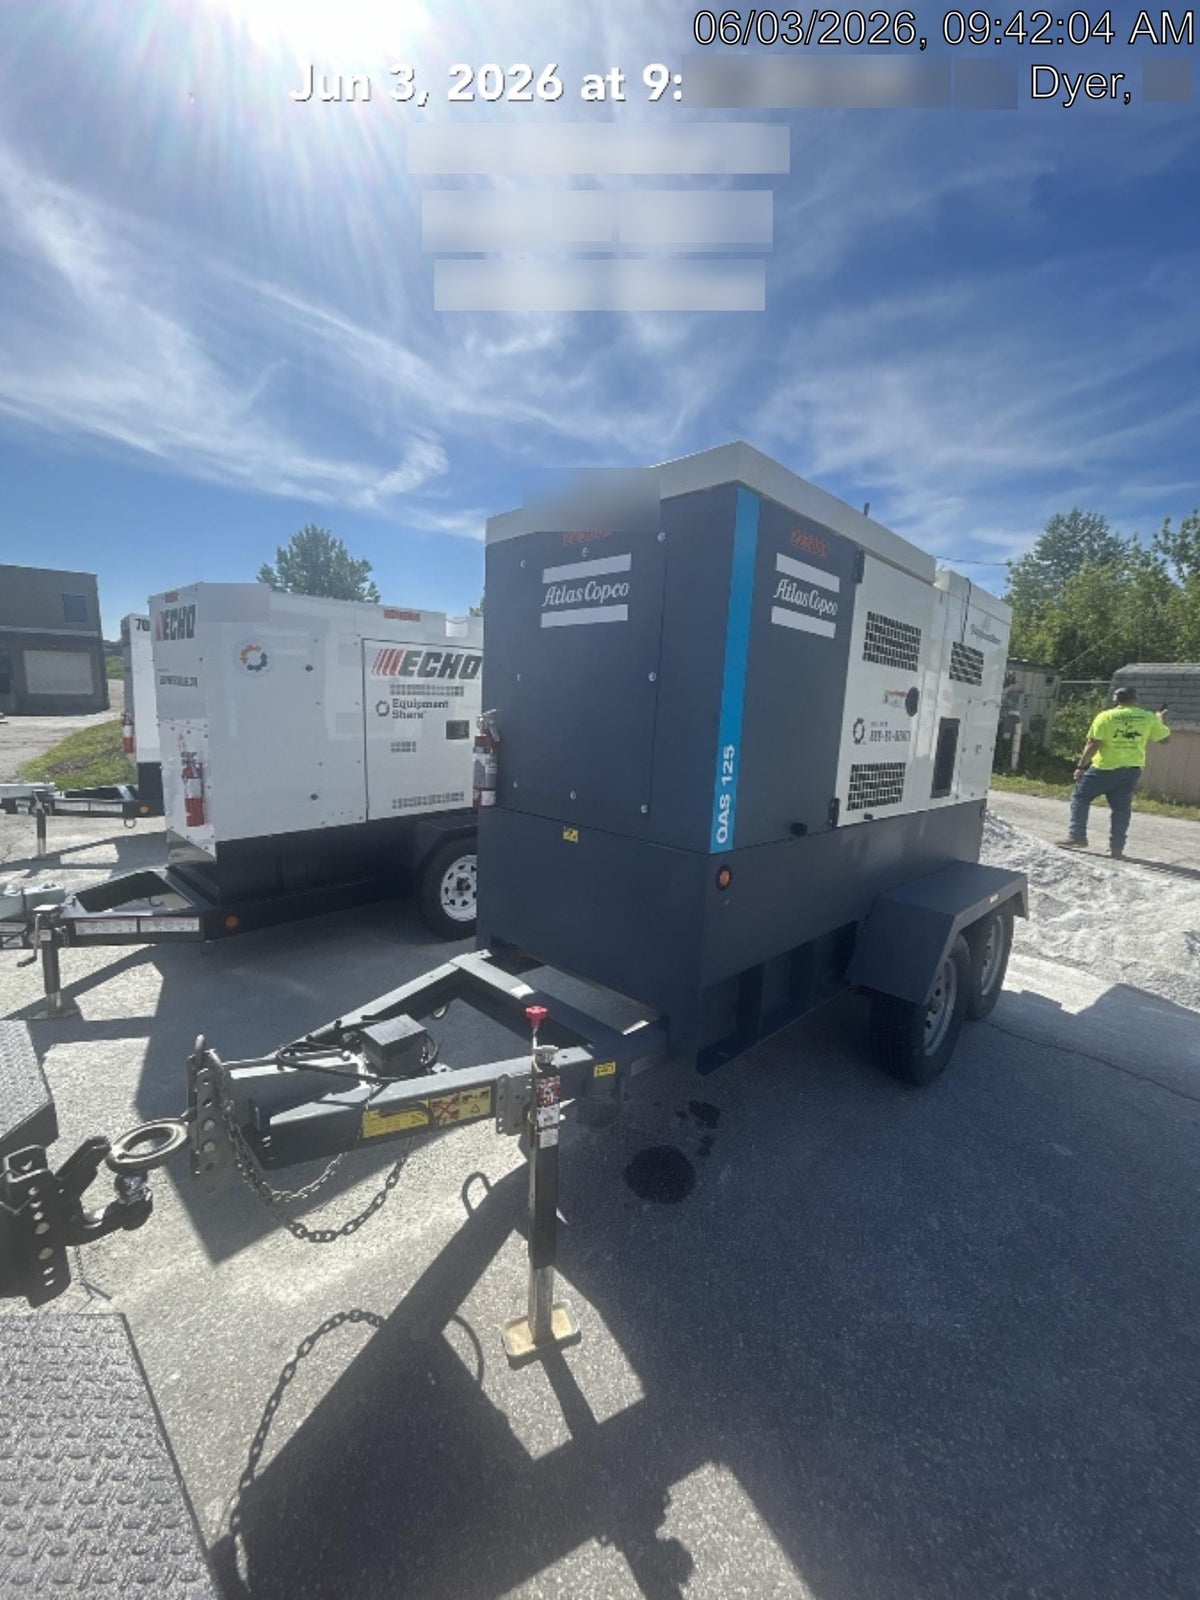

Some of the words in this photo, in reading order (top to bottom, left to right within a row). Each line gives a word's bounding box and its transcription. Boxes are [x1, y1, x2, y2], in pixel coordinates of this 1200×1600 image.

[162, 603, 196, 641] ECHO
[397, 649, 483, 680] ECHO
[392, 697, 450, 710] Equipment
[721, 743, 736, 788] 125
